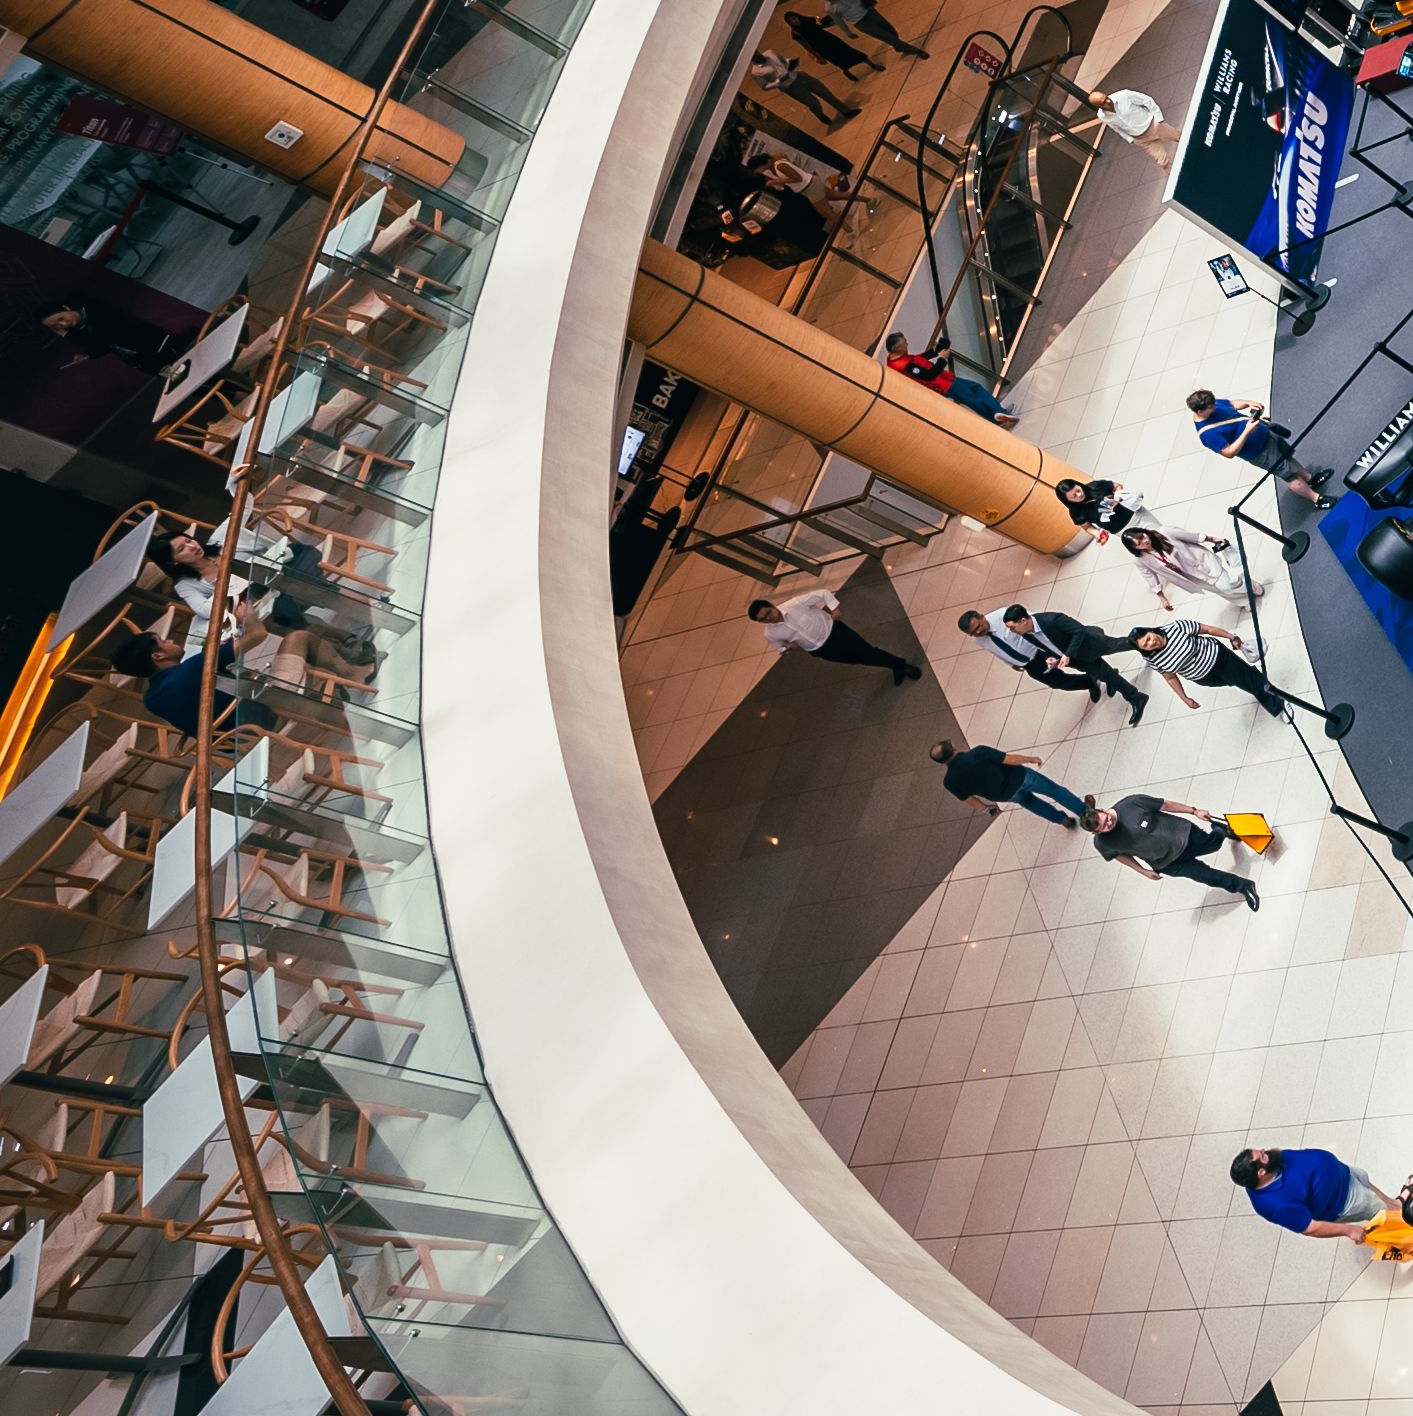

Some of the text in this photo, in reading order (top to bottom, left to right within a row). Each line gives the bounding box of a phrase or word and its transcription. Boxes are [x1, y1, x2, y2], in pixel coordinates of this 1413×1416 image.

[1213, 48, 1232, 93] WILLIAMS
[1223, 59, 1238, 95] RACING
[2, 78, 47, 131] SOLVING
[1295, 90, 1329, 240] KOMATSU
[651, 369, 682, 409] BAK
